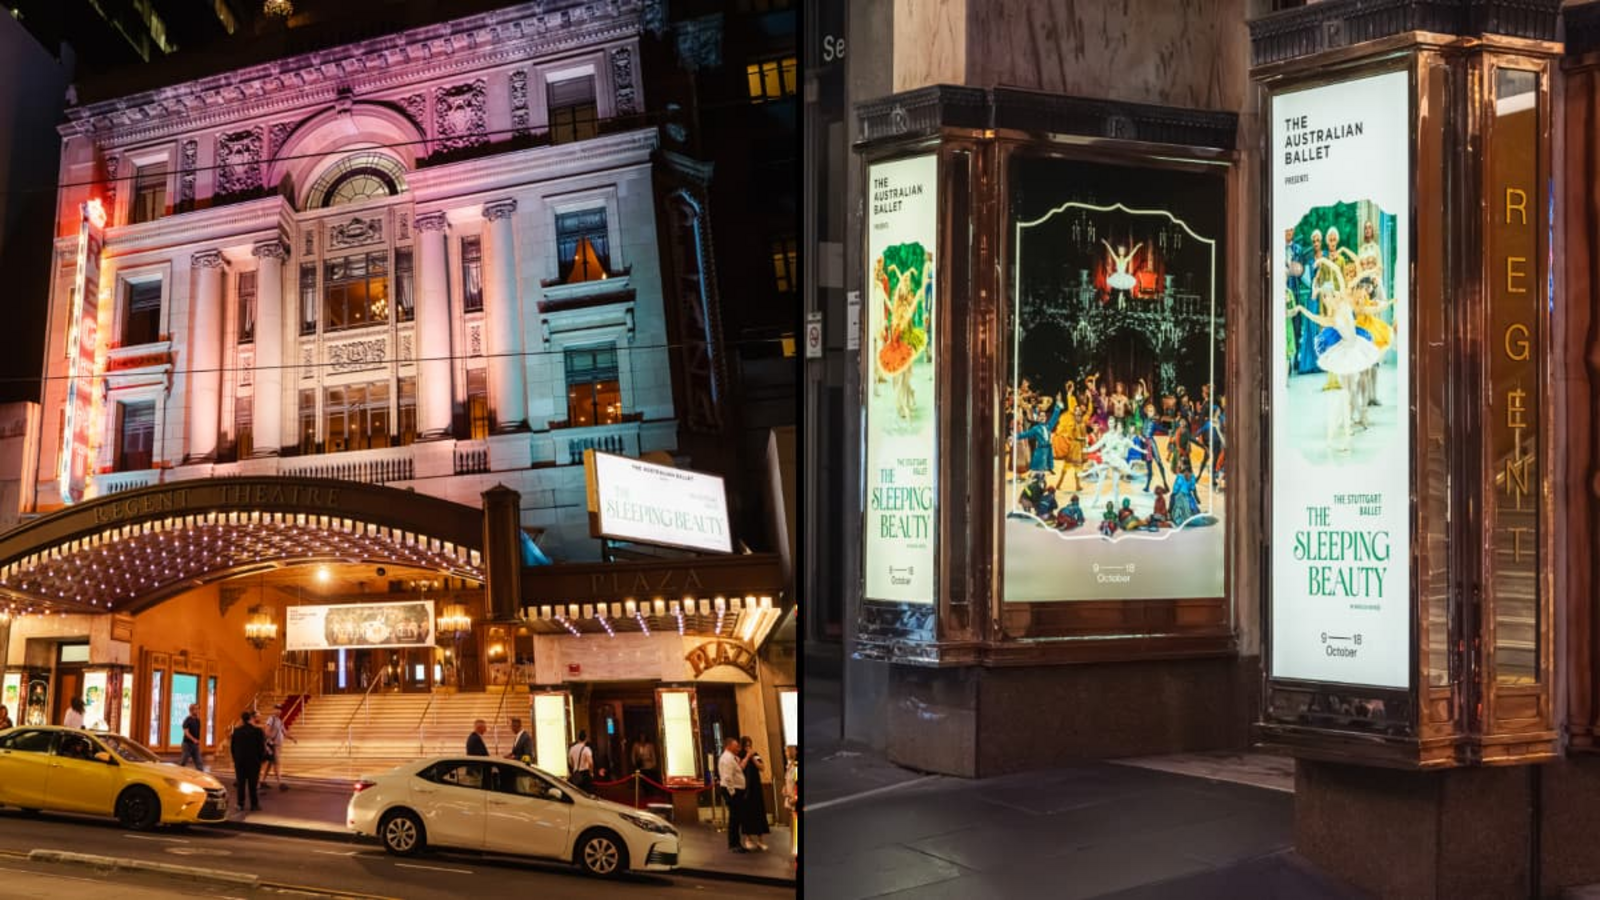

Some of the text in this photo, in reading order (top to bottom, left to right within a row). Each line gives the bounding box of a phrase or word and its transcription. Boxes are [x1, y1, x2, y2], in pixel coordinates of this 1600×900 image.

[1284, 115, 1308, 132] THE
[1284, 121, 1364, 149] AUSTRALIAN
[1284, 144, 1331, 165] BALLET
[874, 176, 889, 189] THE
[874, 183, 924, 201] AUSTRALIAN
[874, 200, 903, 215] BALLET
[72, 231, 100, 477] REGENT
[1504, 187, 1531, 563] REGENT
[881, 469, 895, 483] THE
[94, 485, 341, 524] REGENT THEATRE
[871, 487, 933, 511] SLEEPING
[1347, 493, 1382, 504] STUTTGART
[606, 499, 725, 536] SLEEPING BEAUTY
[880, 514, 930, 539] BEAUTY
[1306, 506, 1331, 527] THE
[1293, 530, 1390, 562] SLEEPING
[590, 568, 705, 594] PLAZA
[1308, 566, 1387, 598] BEAUTY
[685, 640, 759, 681] PLAZA
[1326, 645, 1358, 658] October
